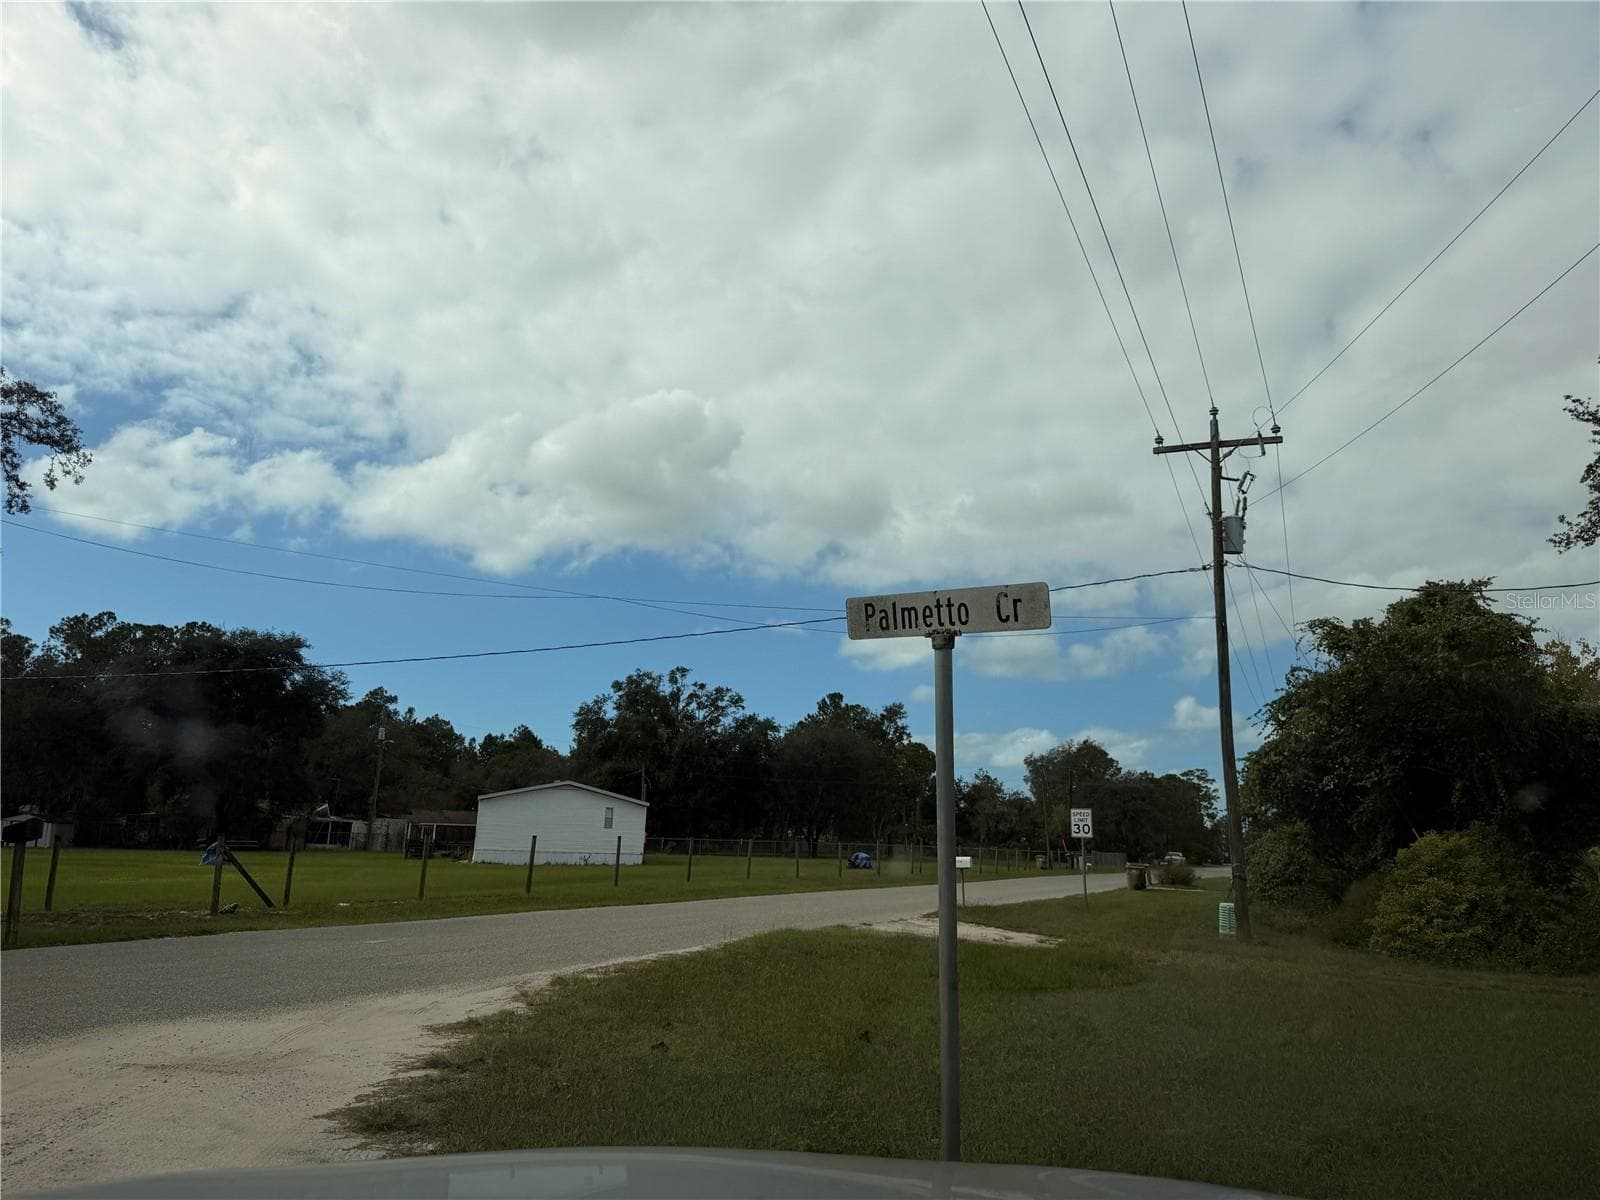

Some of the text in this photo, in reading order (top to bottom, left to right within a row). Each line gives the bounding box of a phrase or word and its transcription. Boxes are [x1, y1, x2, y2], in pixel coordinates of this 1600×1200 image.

[864, 592, 1023, 632] Palmetto Cr
[1073, 824, 1091, 835] 30
